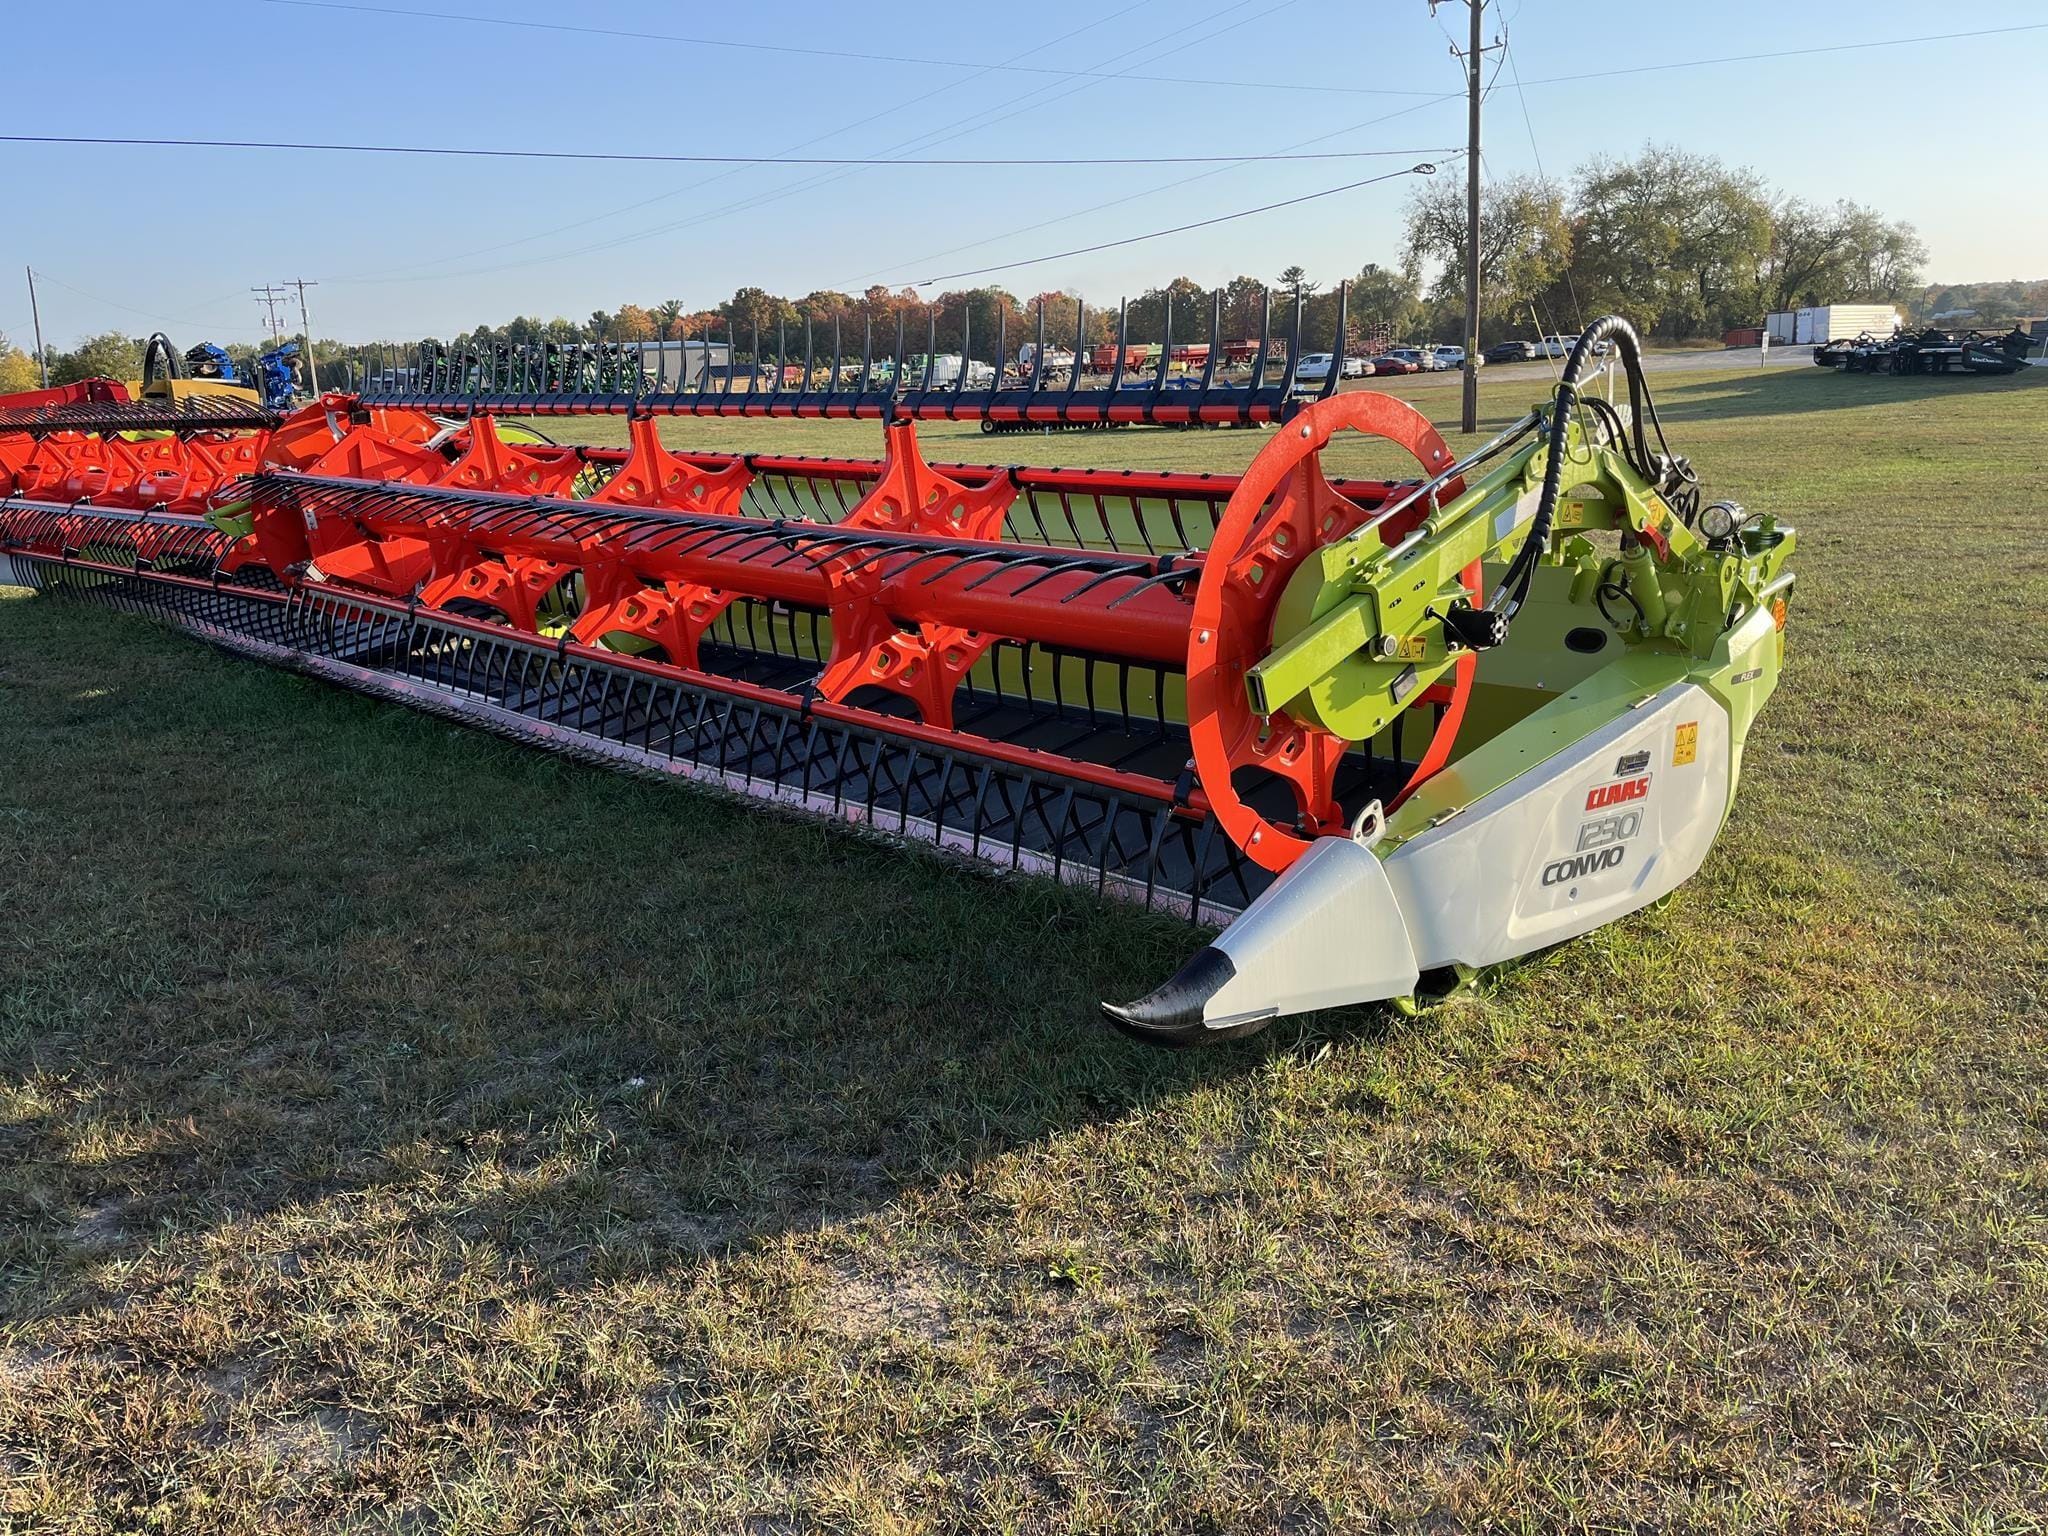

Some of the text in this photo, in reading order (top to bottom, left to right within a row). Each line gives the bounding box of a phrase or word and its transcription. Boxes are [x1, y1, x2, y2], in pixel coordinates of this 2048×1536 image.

[1585, 777, 1649, 811] CLAAS
[1578, 812, 1641, 852] 1230
[1542, 845, 1625, 886] CONVIO
